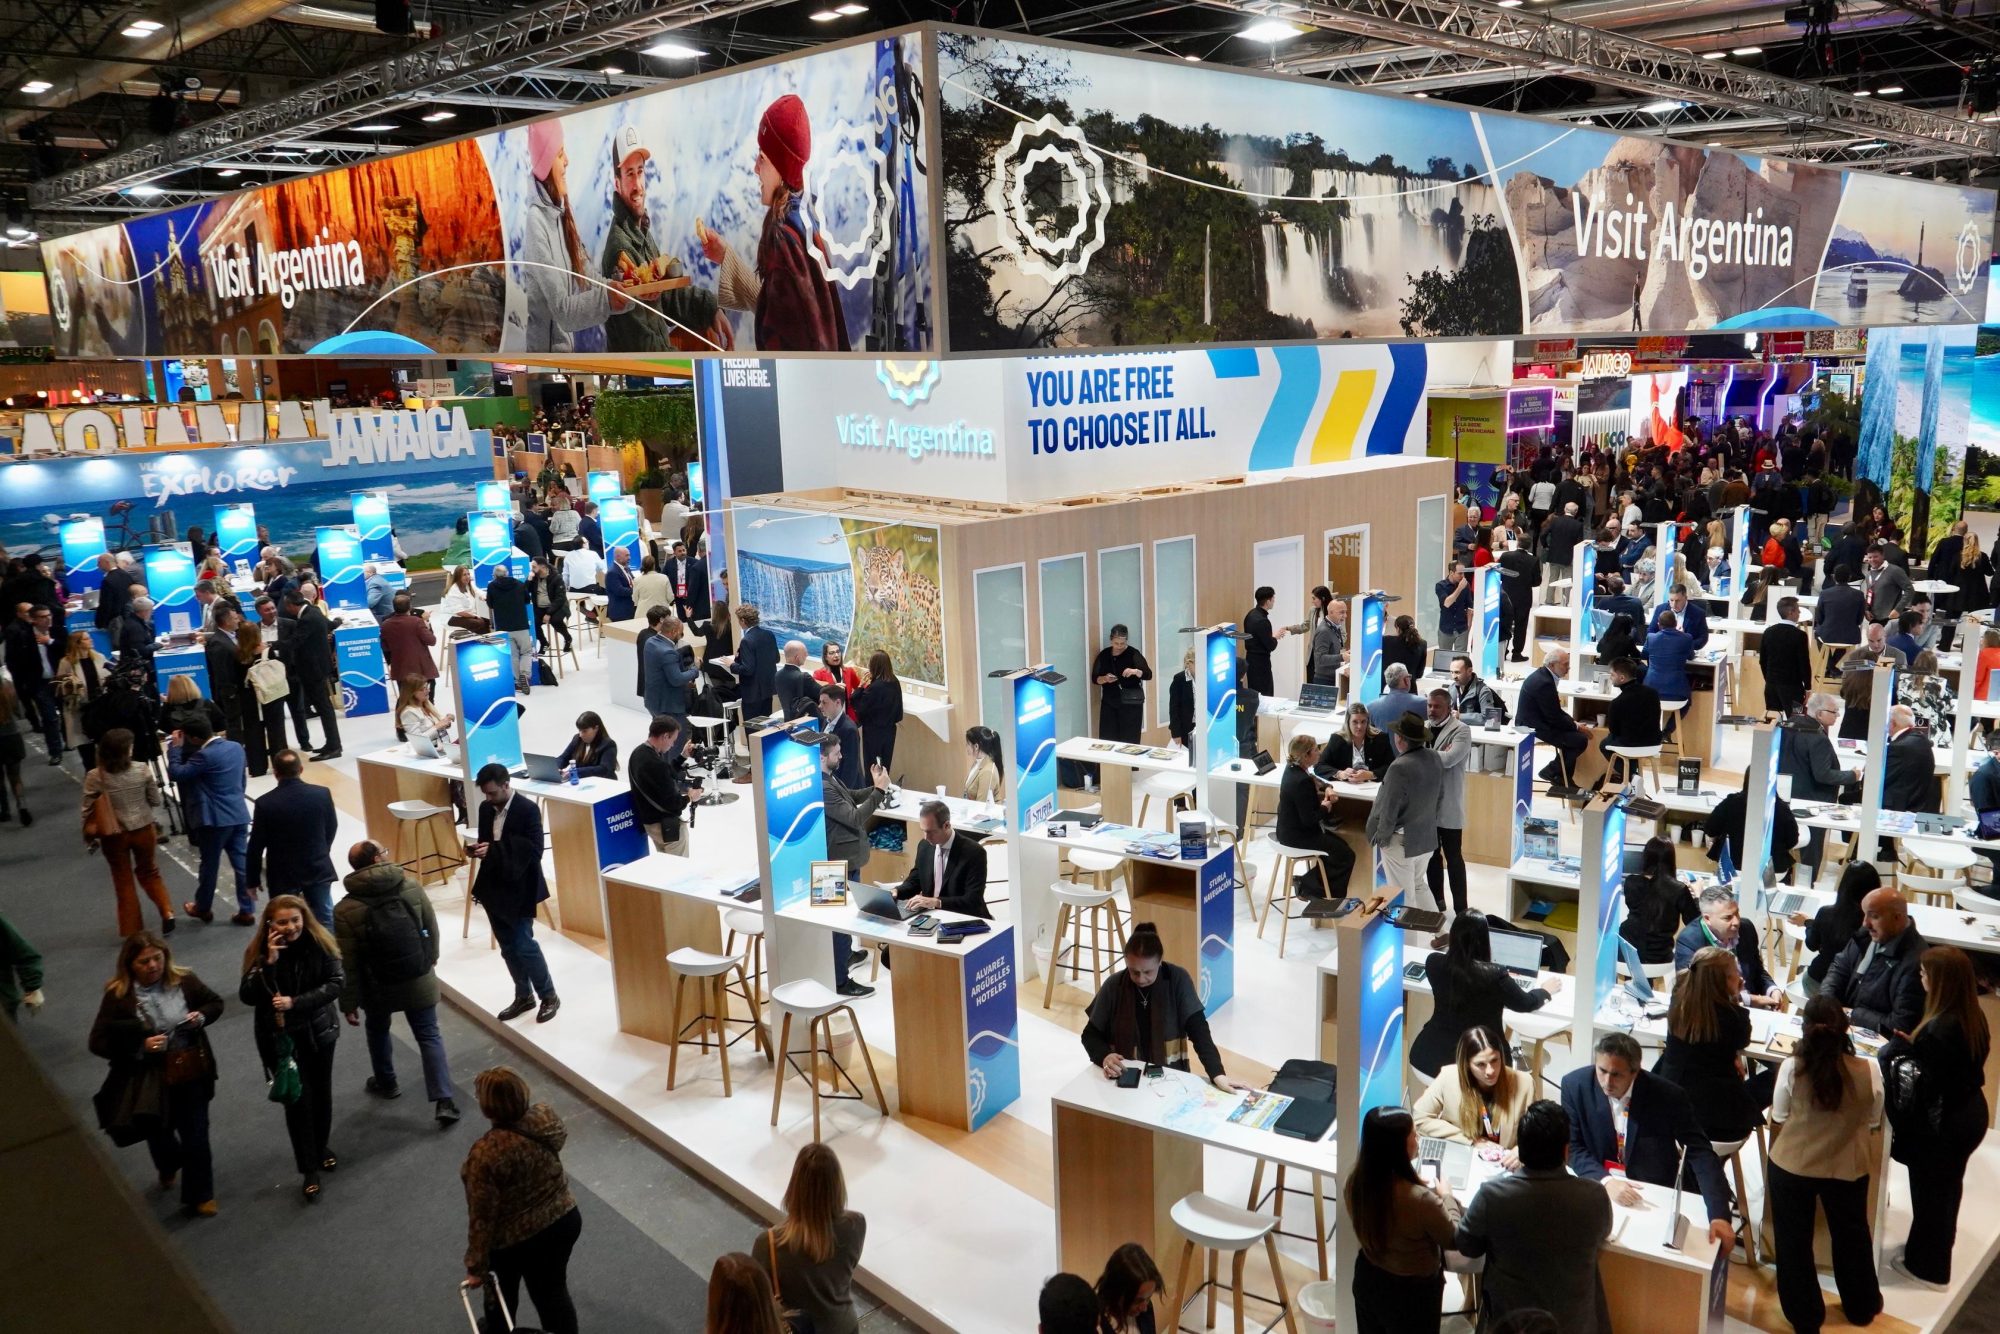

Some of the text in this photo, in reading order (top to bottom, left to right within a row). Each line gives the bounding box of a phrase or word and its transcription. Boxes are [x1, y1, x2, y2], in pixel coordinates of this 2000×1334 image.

[1572, 190, 1793, 281] Visit Argentina
[210, 226, 365, 309] Visit Argentina
[1582, 352, 1632, 377] JALISCO
[723, 369, 771, 388] LIVES HERE.
[1026, 365, 1174, 408] YOU ARE FREE
[321, 406, 476, 467] JAMAICA
[835, 412, 994, 459] Visit Argentina
[1028, 406, 1216, 455] TO CHOOSE IT ALL.
[338, 637, 379, 646] RESTAURANTE
[606, 809, 634, 825] TANGOL
[609, 818, 634, 833] TOURS
[1203, 878, 1232, 905] NAVEGACIÓN
[1209, 871, 1227, 889] STURLA
[971, 965, 1011, 998] ARGÜELLES
[975, 955, 1005, 982] ALVAREZ
[976, 979, 1007, 1007] HOTELES
